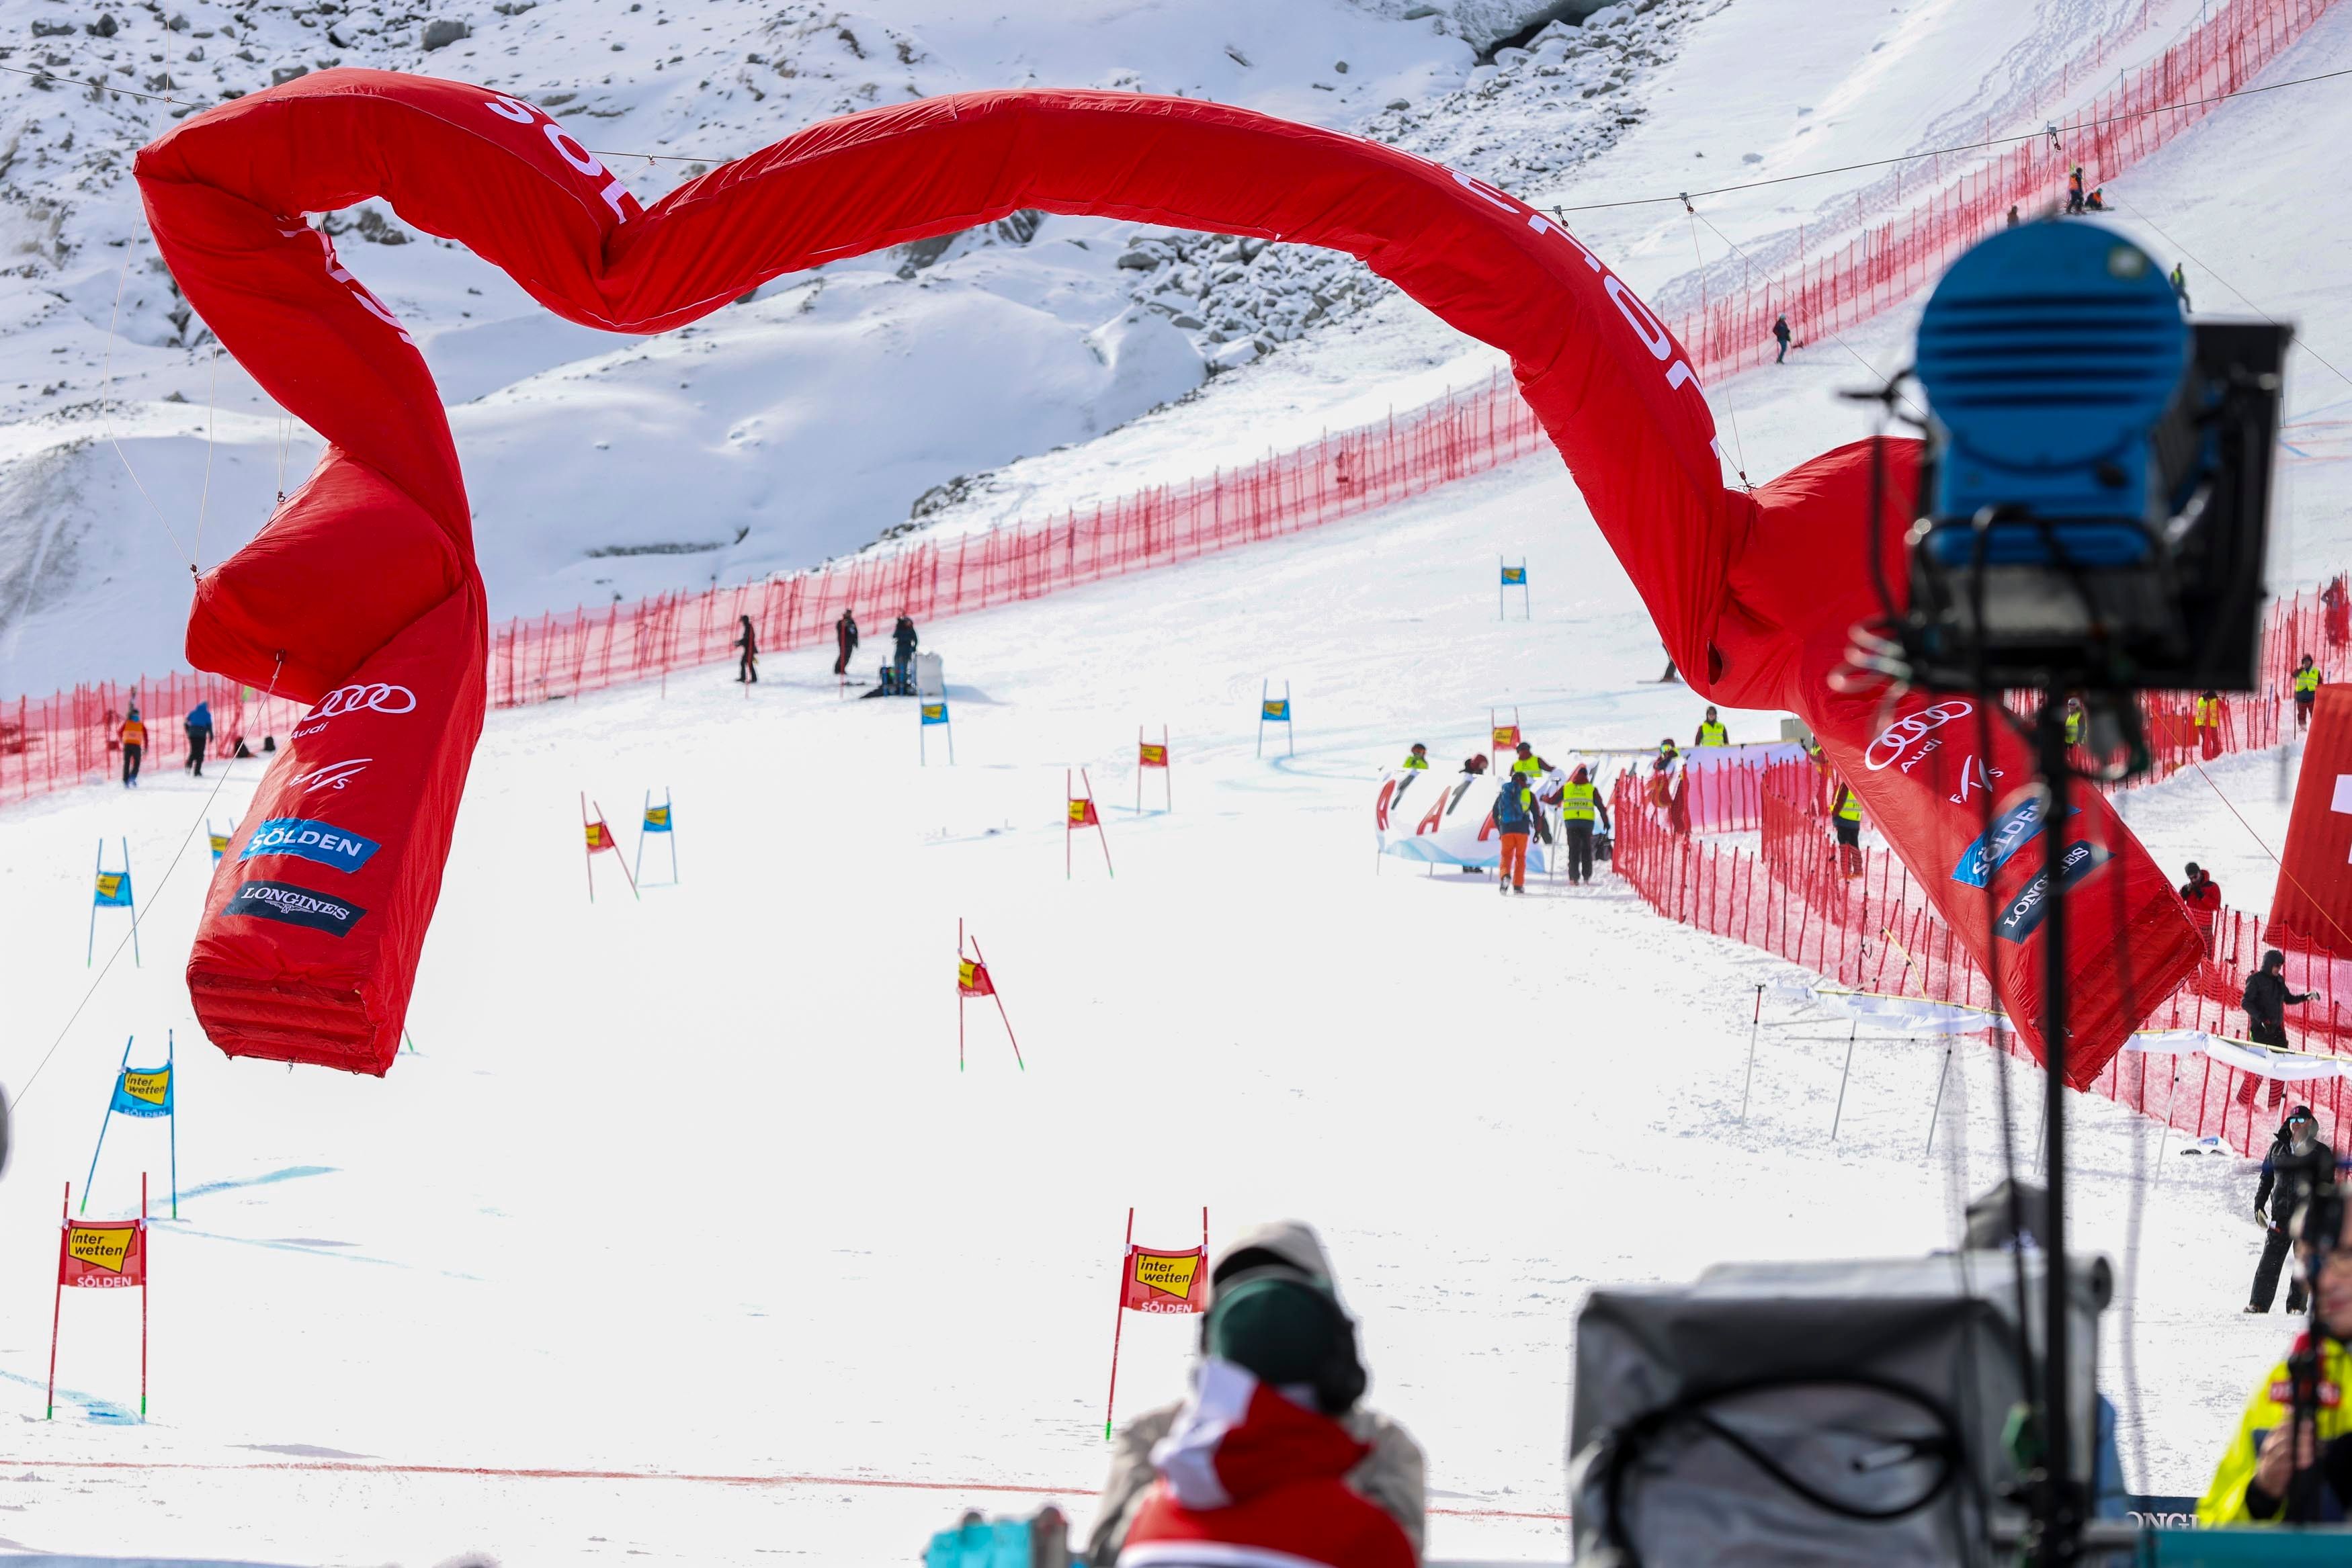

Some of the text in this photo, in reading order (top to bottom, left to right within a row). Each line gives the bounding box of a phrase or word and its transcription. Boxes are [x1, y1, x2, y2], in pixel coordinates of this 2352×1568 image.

[290, 722, 329, 740] Audi
[1900, 738, 1943, 774] Audi
[249, 827, 363, 857] SÖLDEN
[2004, 846, 2089, 928] LONGES
[241, 887, 350, 920] LONGINES
[127, 1074, 154, 1087] inter
[128, 1085, 165, 1095] wetten
[72, 1228, 105, 1245] inter
[75, 1245, 123, 1256] wetten
[1140, 1256, 1175, 1272] inter
[77, 1275, 132, 1288] SÖLDEN
[1144, 1272, 1190, 1283] wetten
[1141, 1301, 1193, 1314] SÖLDEN
